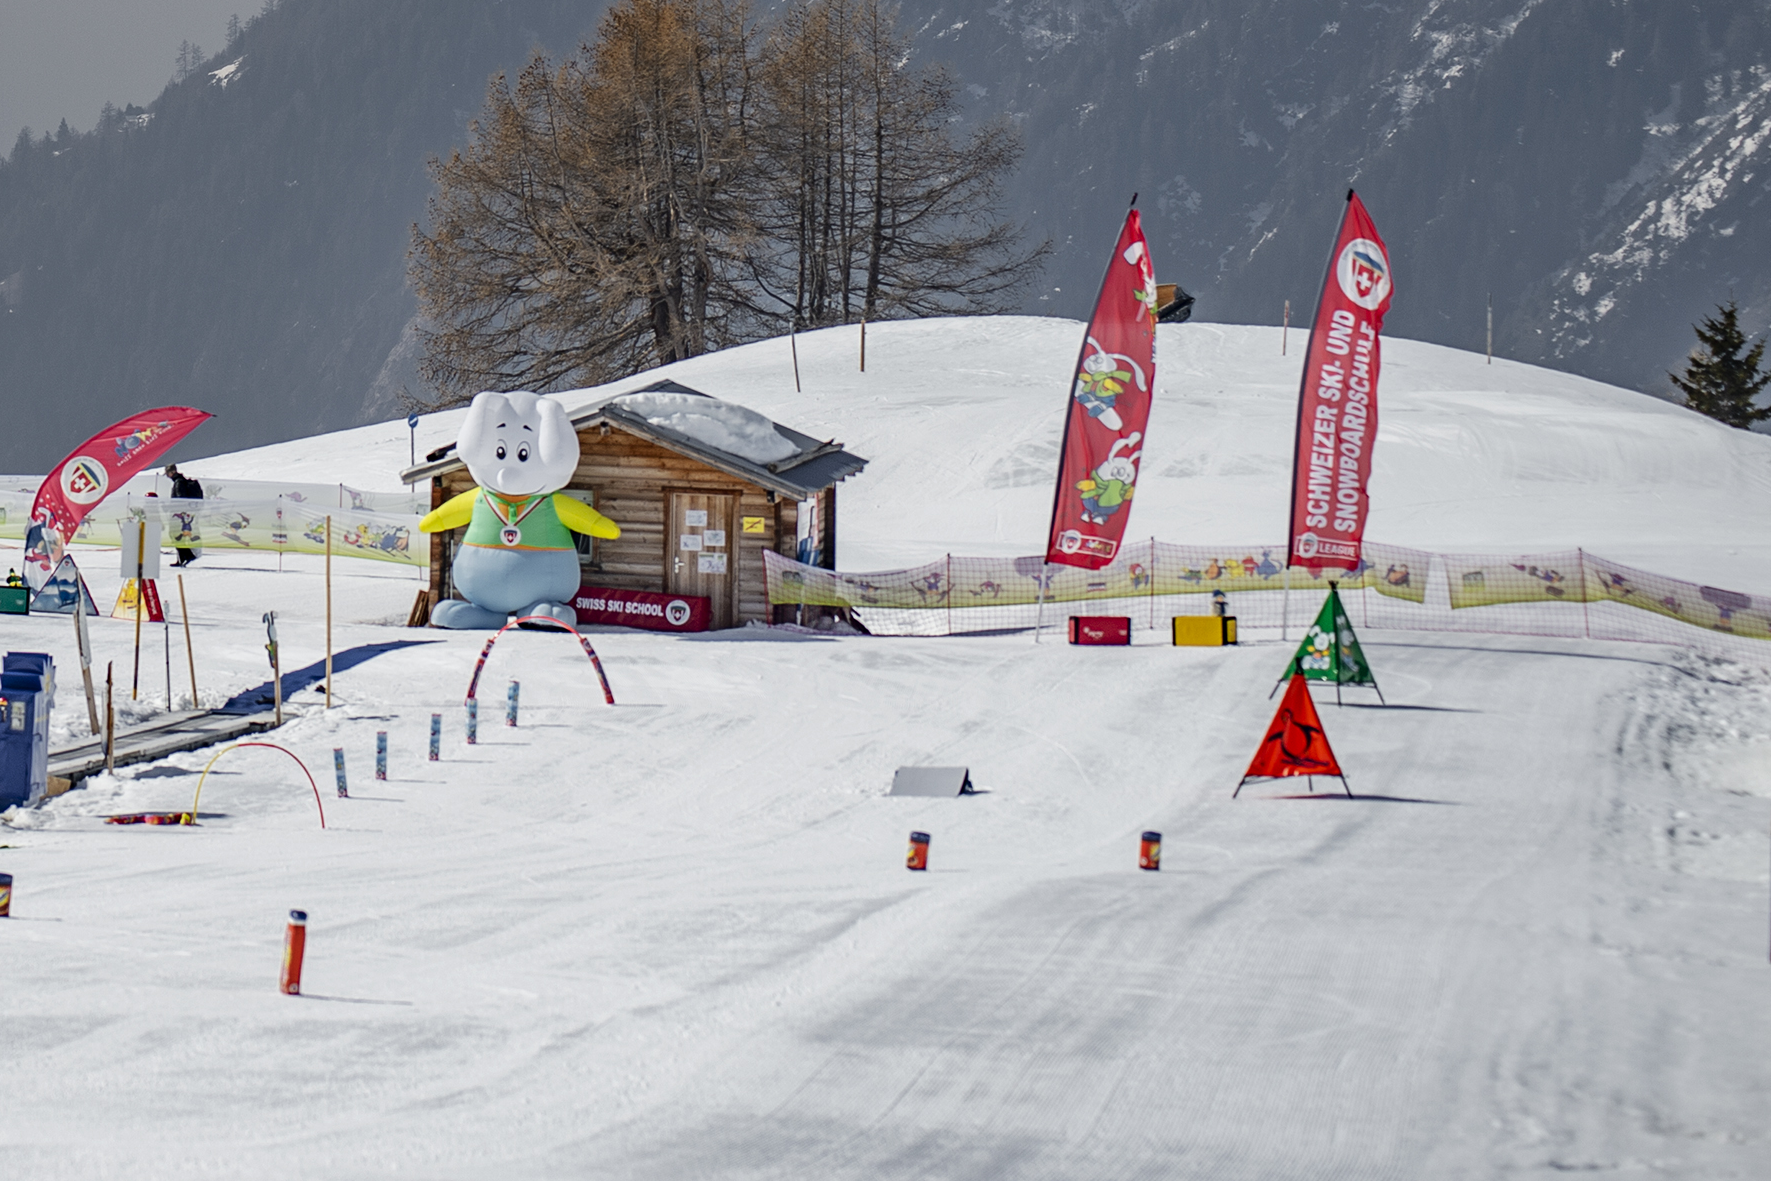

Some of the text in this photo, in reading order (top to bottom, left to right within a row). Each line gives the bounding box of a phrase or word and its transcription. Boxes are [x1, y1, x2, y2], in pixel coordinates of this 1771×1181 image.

[1306, 310, 1355, 528] SCHWEIZER SKI- UND
[1319, 541, 1356, 557] LEAGUE
[576, 597, 664, 617] SWISS SKI SCHOOL
